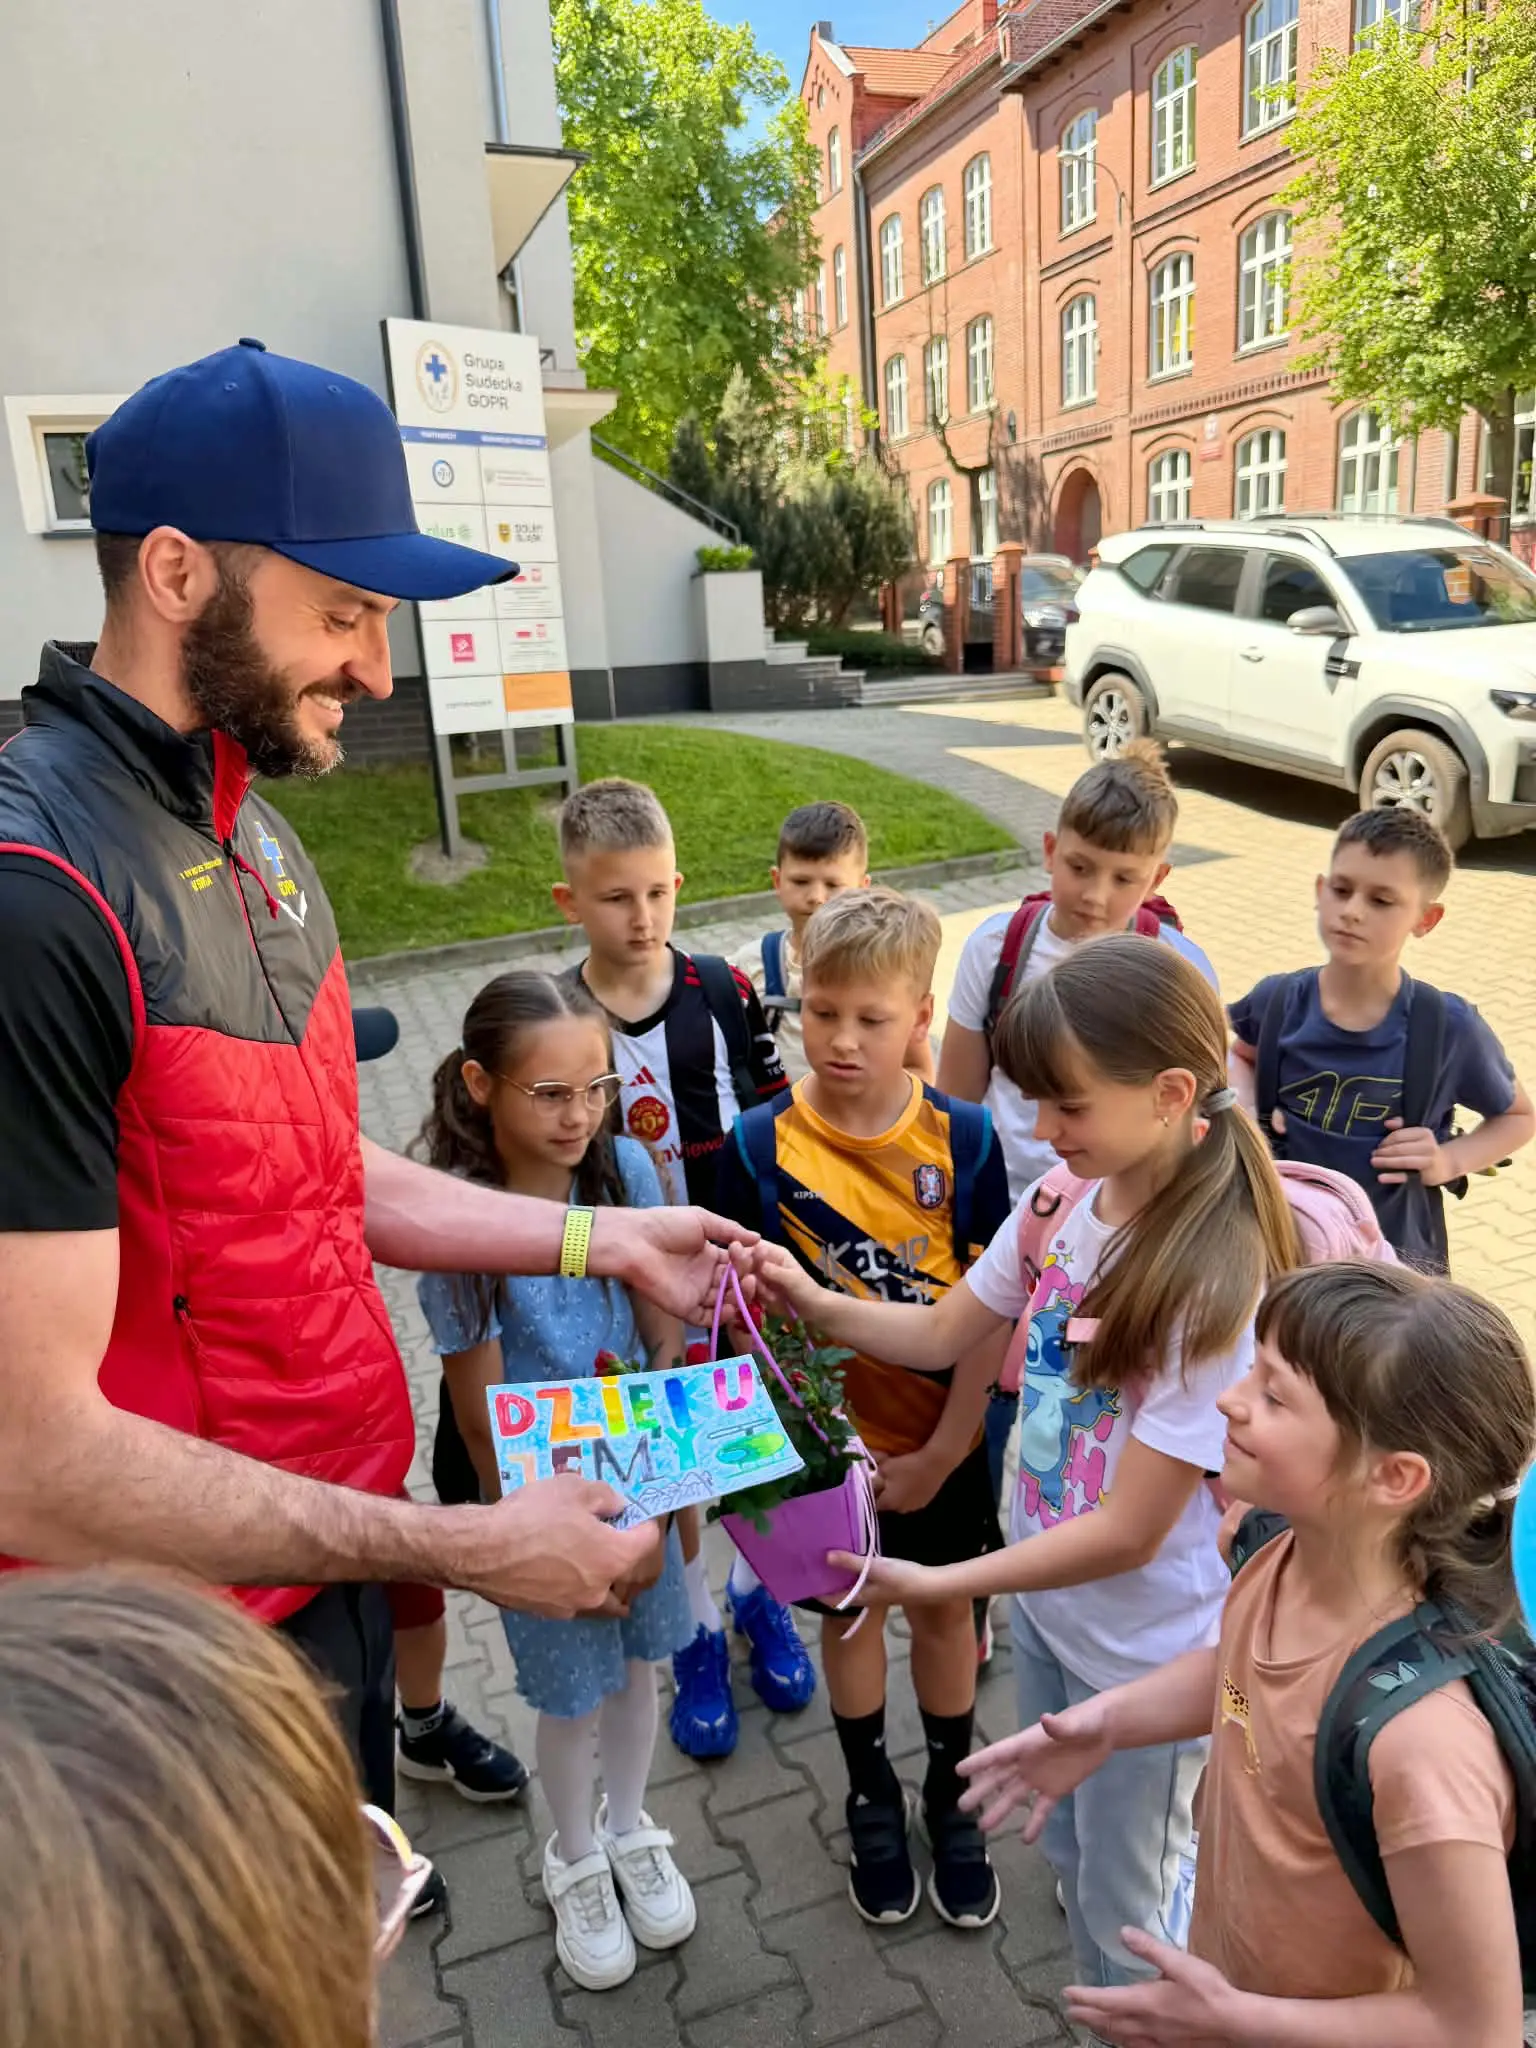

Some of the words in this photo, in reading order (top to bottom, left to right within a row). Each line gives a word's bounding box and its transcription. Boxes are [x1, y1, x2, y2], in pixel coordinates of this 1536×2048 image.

[464, 353, 505, 373] Grupa
[465, 373, 523, 392] Sudecka
[467, 393, 509, 410] GOPR
